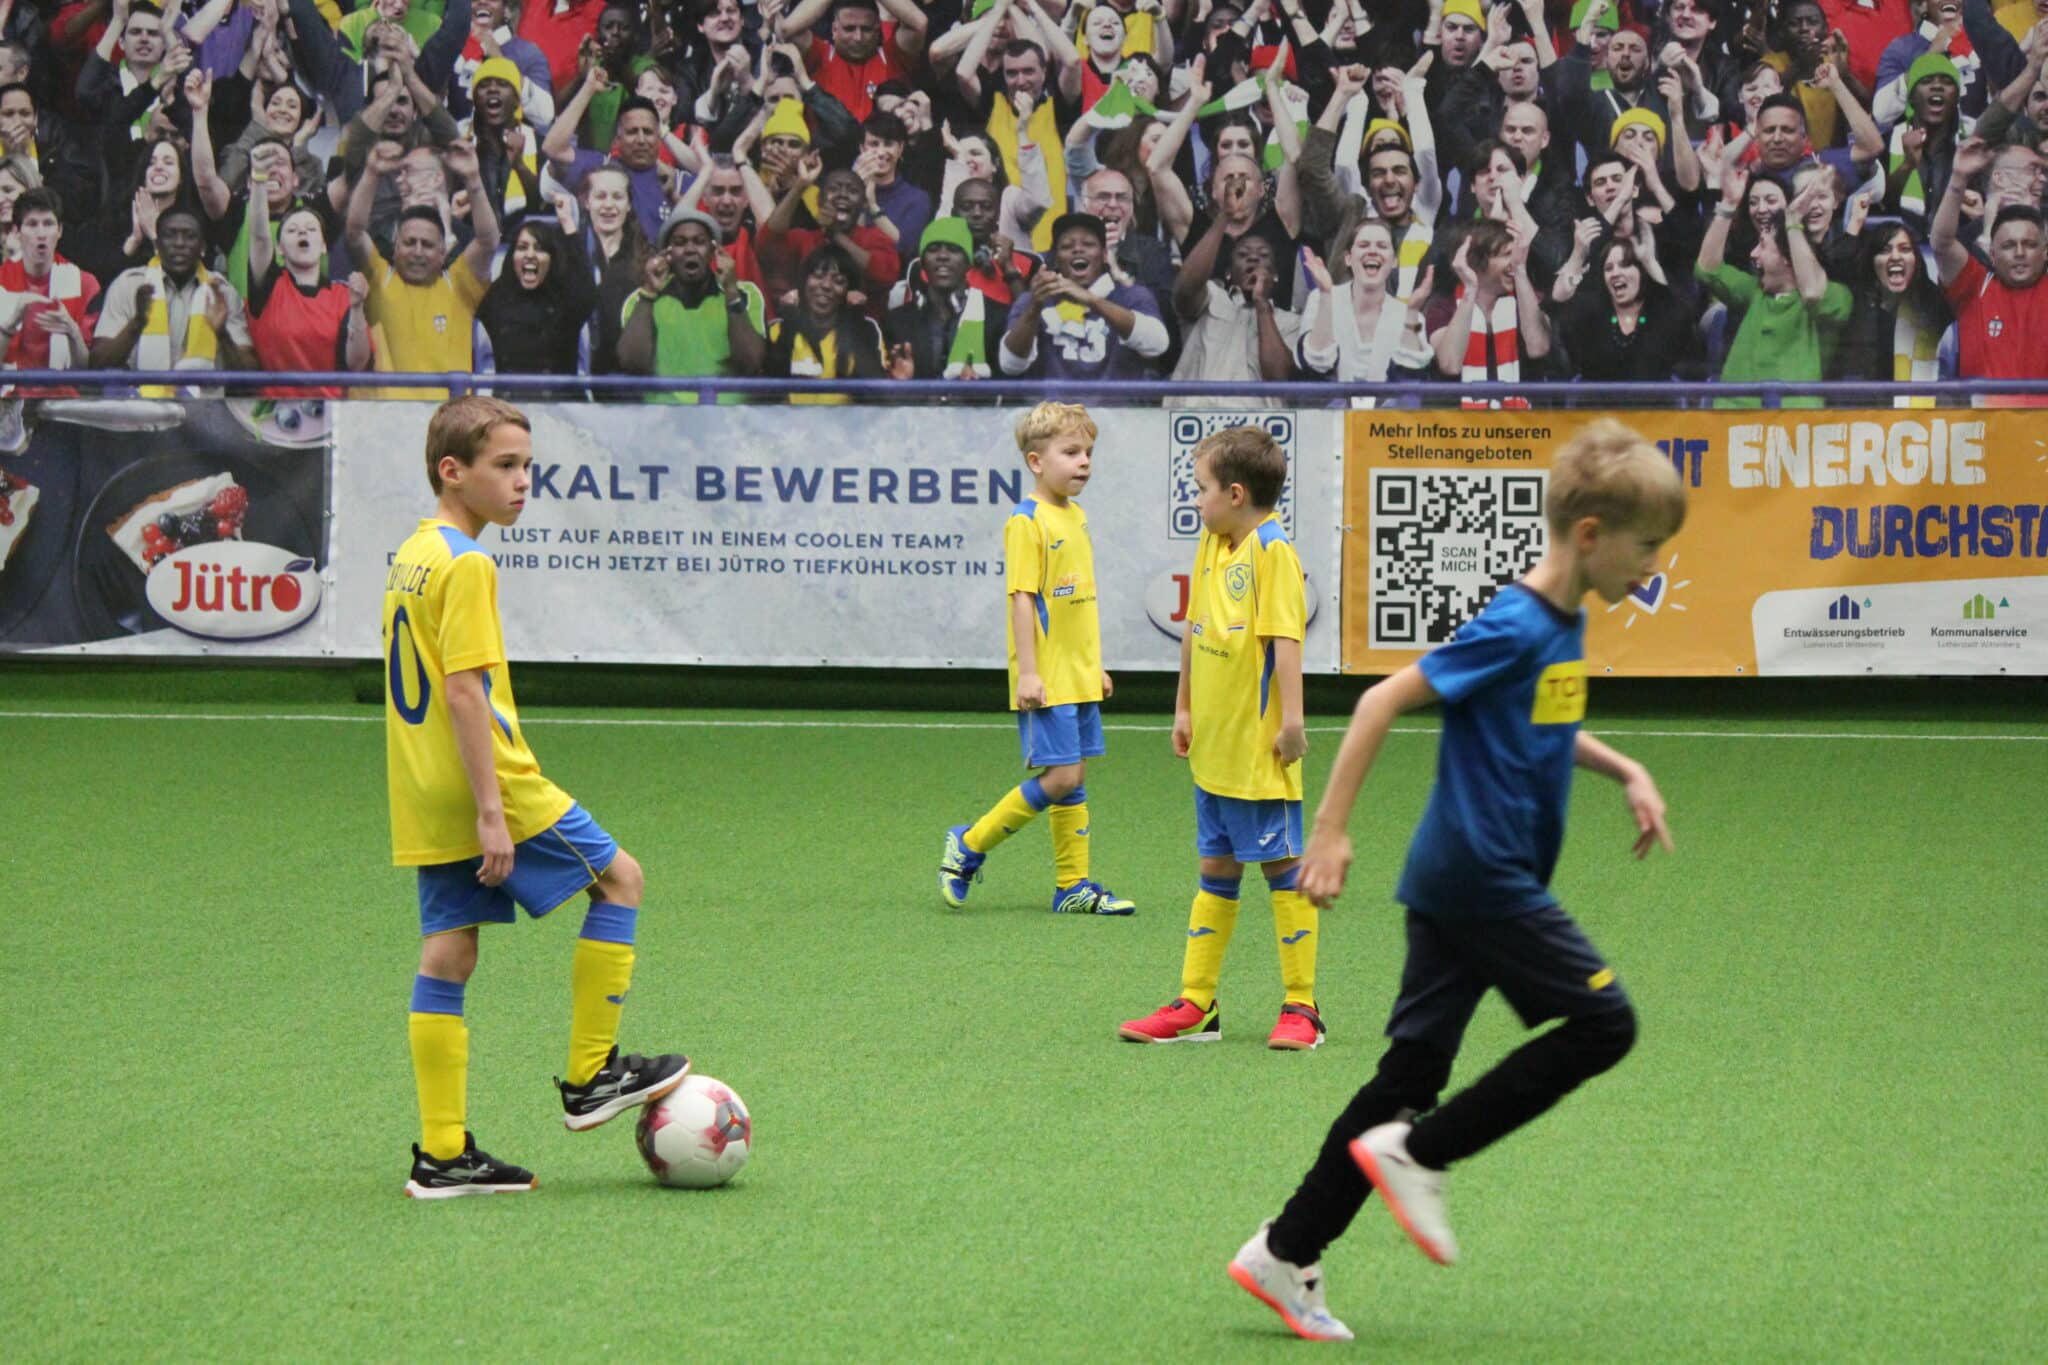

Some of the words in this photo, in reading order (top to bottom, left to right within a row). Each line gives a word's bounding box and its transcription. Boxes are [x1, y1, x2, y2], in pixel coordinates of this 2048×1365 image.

[1369, 422, 1411, 439] Mehr
[1417, 423, 1457, 439] Infos
[1462, 427, 1480, 438] zu
[1485, 427, 1551, 439] unseren
[1388, 444, 1532, 462] Stellenangeboten
[1656, 438, 1709, 487] IT
[1728, 419, 1987, 489] ENERGIE
[531, 463, 670, 500] KALT
[695, 464, 1022, 505] BEWERBEN
[500, 527, 551, 543] LUST
[559, 529, 601, 544] AUF
[607, 529, 684, 546] ARBEIT
[692, 531, 713, 546] IN
[721, 531, 786, 547] EINEM
[795, 532, 883, 549] COOLEN
[891, 533, 964, 549] TEAM?
[1441, 546, 1477, 558] SCAN
[548, 554, 600, 570] DICH
[607, 555, 668, 572] JETZT
[676, 557, 710, 572] BEI
[718, 554, 786, 574] JÜTRO
[793, 556, 957, 576] TIEFKÜHLKOST
[965, 561, 987, 576] IN
[1441, 560, 1477, 572] MICH
[172, 561, 302, 612] Jütro
[1783, 626, 1905, 639] Entwässerungsbetrieb
[1930, 626, 2028, 638] Kommunalservice
